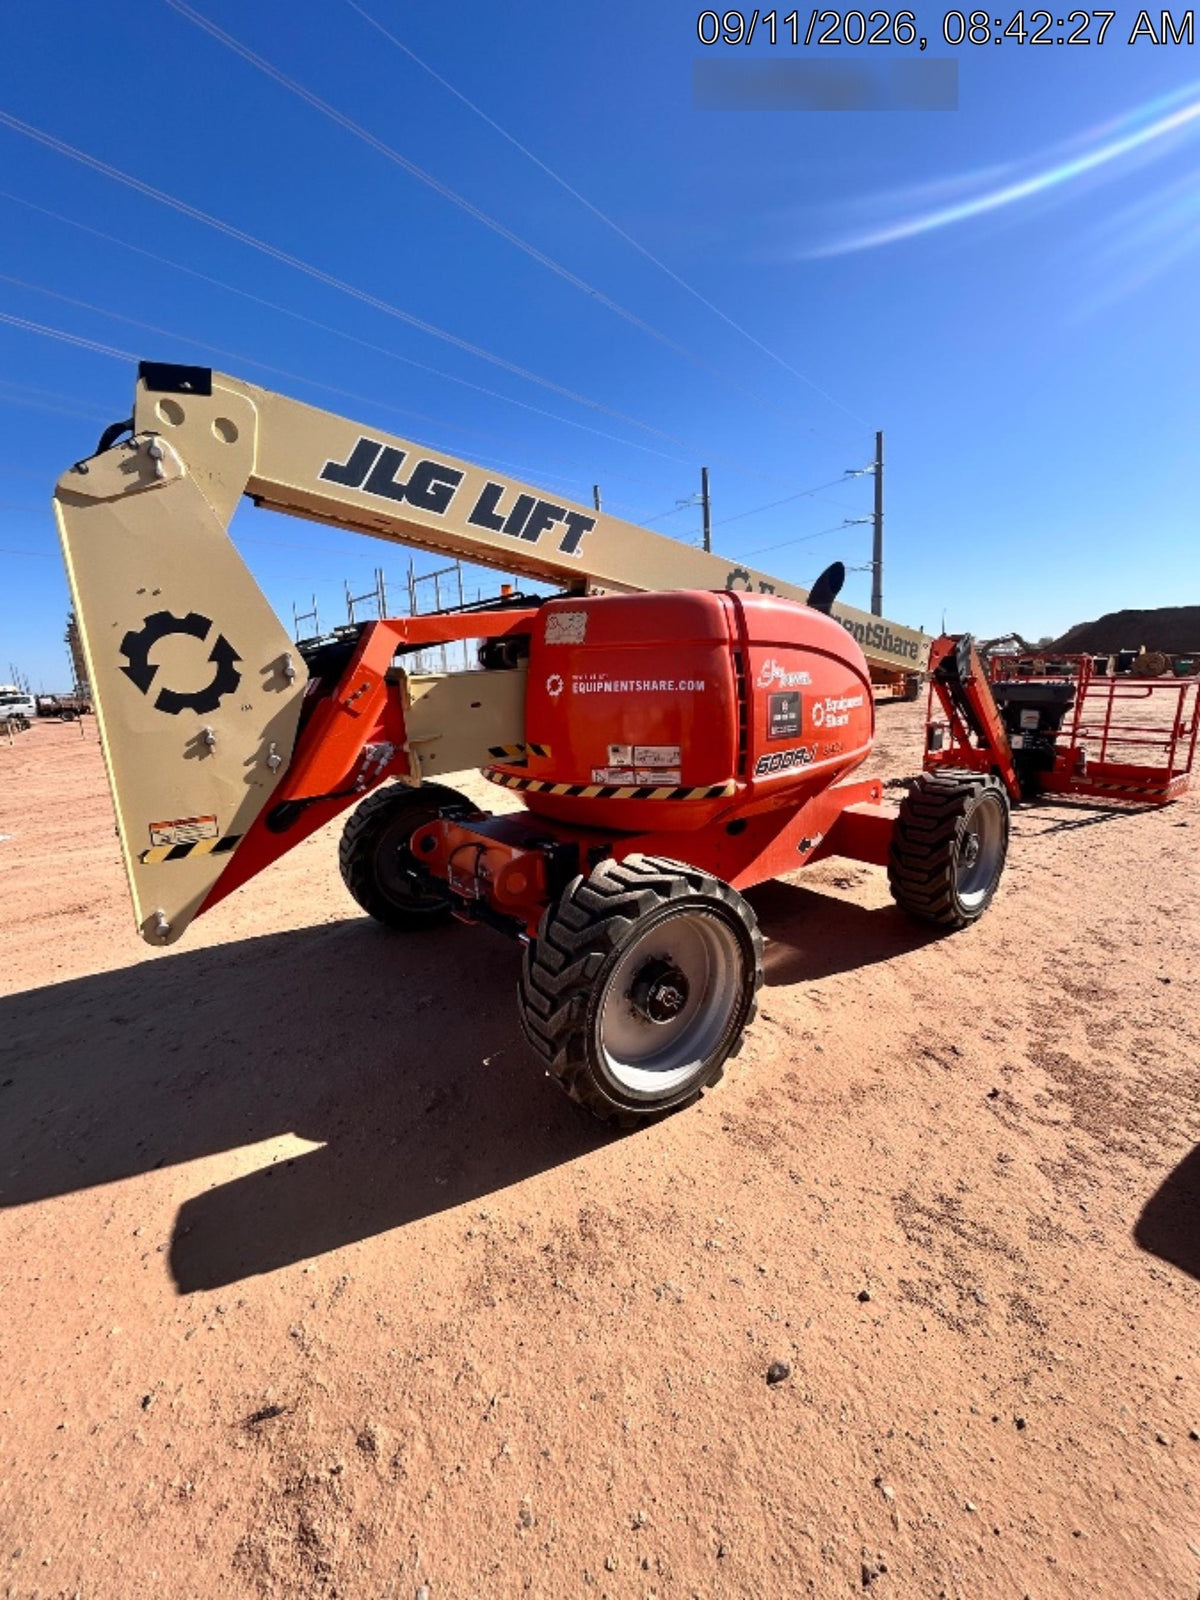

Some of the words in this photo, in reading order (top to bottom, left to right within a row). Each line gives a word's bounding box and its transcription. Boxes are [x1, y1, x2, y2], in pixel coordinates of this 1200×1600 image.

[317, 435, 466, 517] JLG
[467, 480, 597, 556] LIFT
[571, 679, 706, 695] EQUIPMENTSHARE.COM
